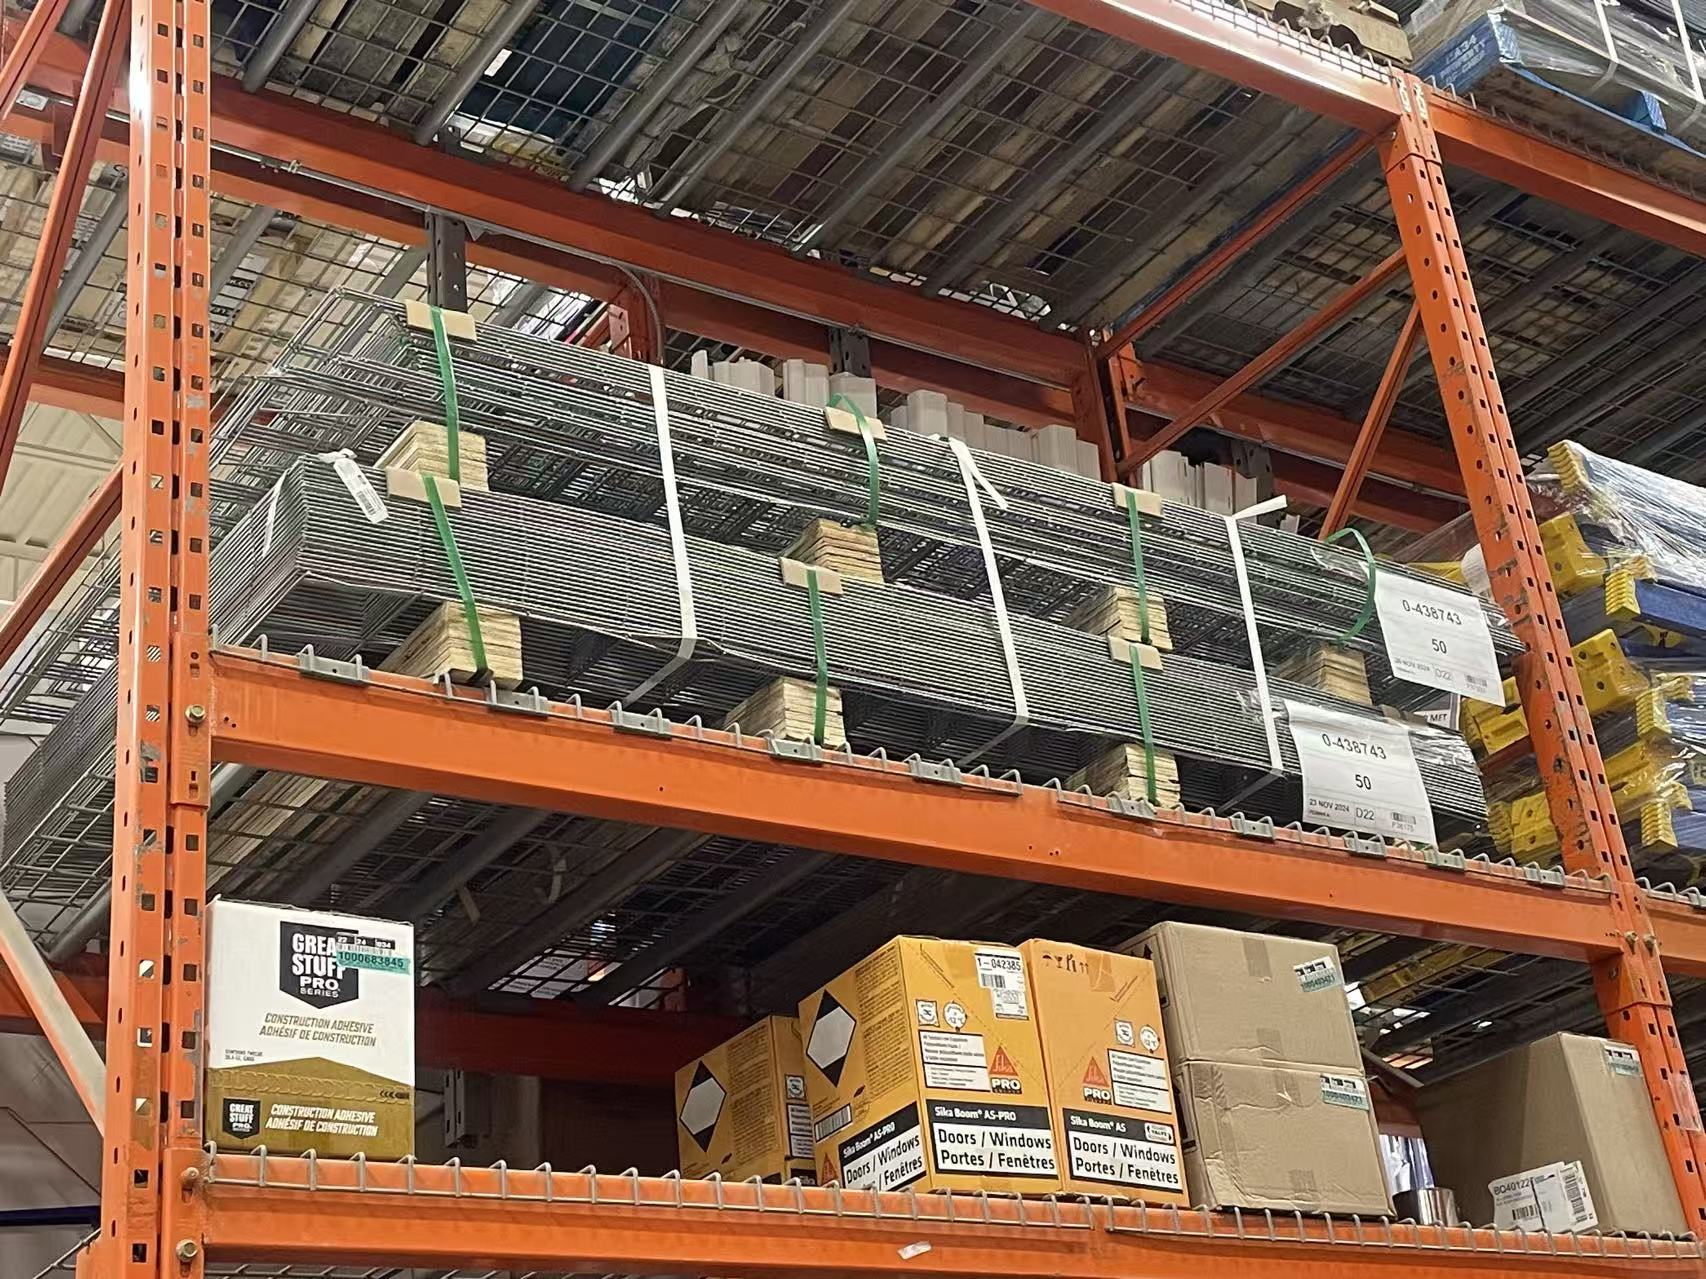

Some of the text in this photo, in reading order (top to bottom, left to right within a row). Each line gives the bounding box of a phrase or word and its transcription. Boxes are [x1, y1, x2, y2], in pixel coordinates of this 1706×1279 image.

[1402, 599, 1462, 625] 0-438743
[1431, 638, 1447, 654] 50
[1435, 668, 1452, 681] D22
[1321, 733, 1387, 760] 0-438743
[1355, 774, 1372, 790] 50
[1318, 800, 1333, 809] NOV
[1334, 803, 1350, 813] 2024
[1355, 807, 1375, 821] D22
[291, 932, 337, 957] GREA
[339, 951, 405, 968] 1000683845
[300, 975, 340, 991] PRO
[300, 987, 339, 998] SERIES
[264, 1012, 375, 1034] CONSTRUCTION ADHESIVE
[259, 1025, 377, 1047] ADHÉSIF DE CONSTRUCTION
[991, 1078, 1021, 1090] PRO
[1083, 1087, 1111, 1100] PRO
[229, 1103, 254, 1114] GREAT
[270, 1104, 376, 1123] CONSTRUCTION ADHESIVE
[934, 1106, 954, 1118] Sika
[984, 1109, 1017, 1121] AS-PRO
[229, 1112, 254, 1123] STUFF
[1070, 1115, 1088, 1127] Sika
[1116, 1122, 1127, 1132] AS
[265, 1117, 379, 1137] ADHÉSIF DE CONSTRUCTION
[938, 1128, 1051, 1149] Doors / Windows
[1073, 1136, 1176, 1164] Doors / Windows
[846, 1162, 871, 1184] Doors
[877, 1135, 920, 1166] Windows
[941, 1149, 1055, 1170] Portes / Fenêtres
[884, 1156, 923, 1185] Fenêtres
[1075, 1157, 1179, 1184] Portes / Fenêtres
